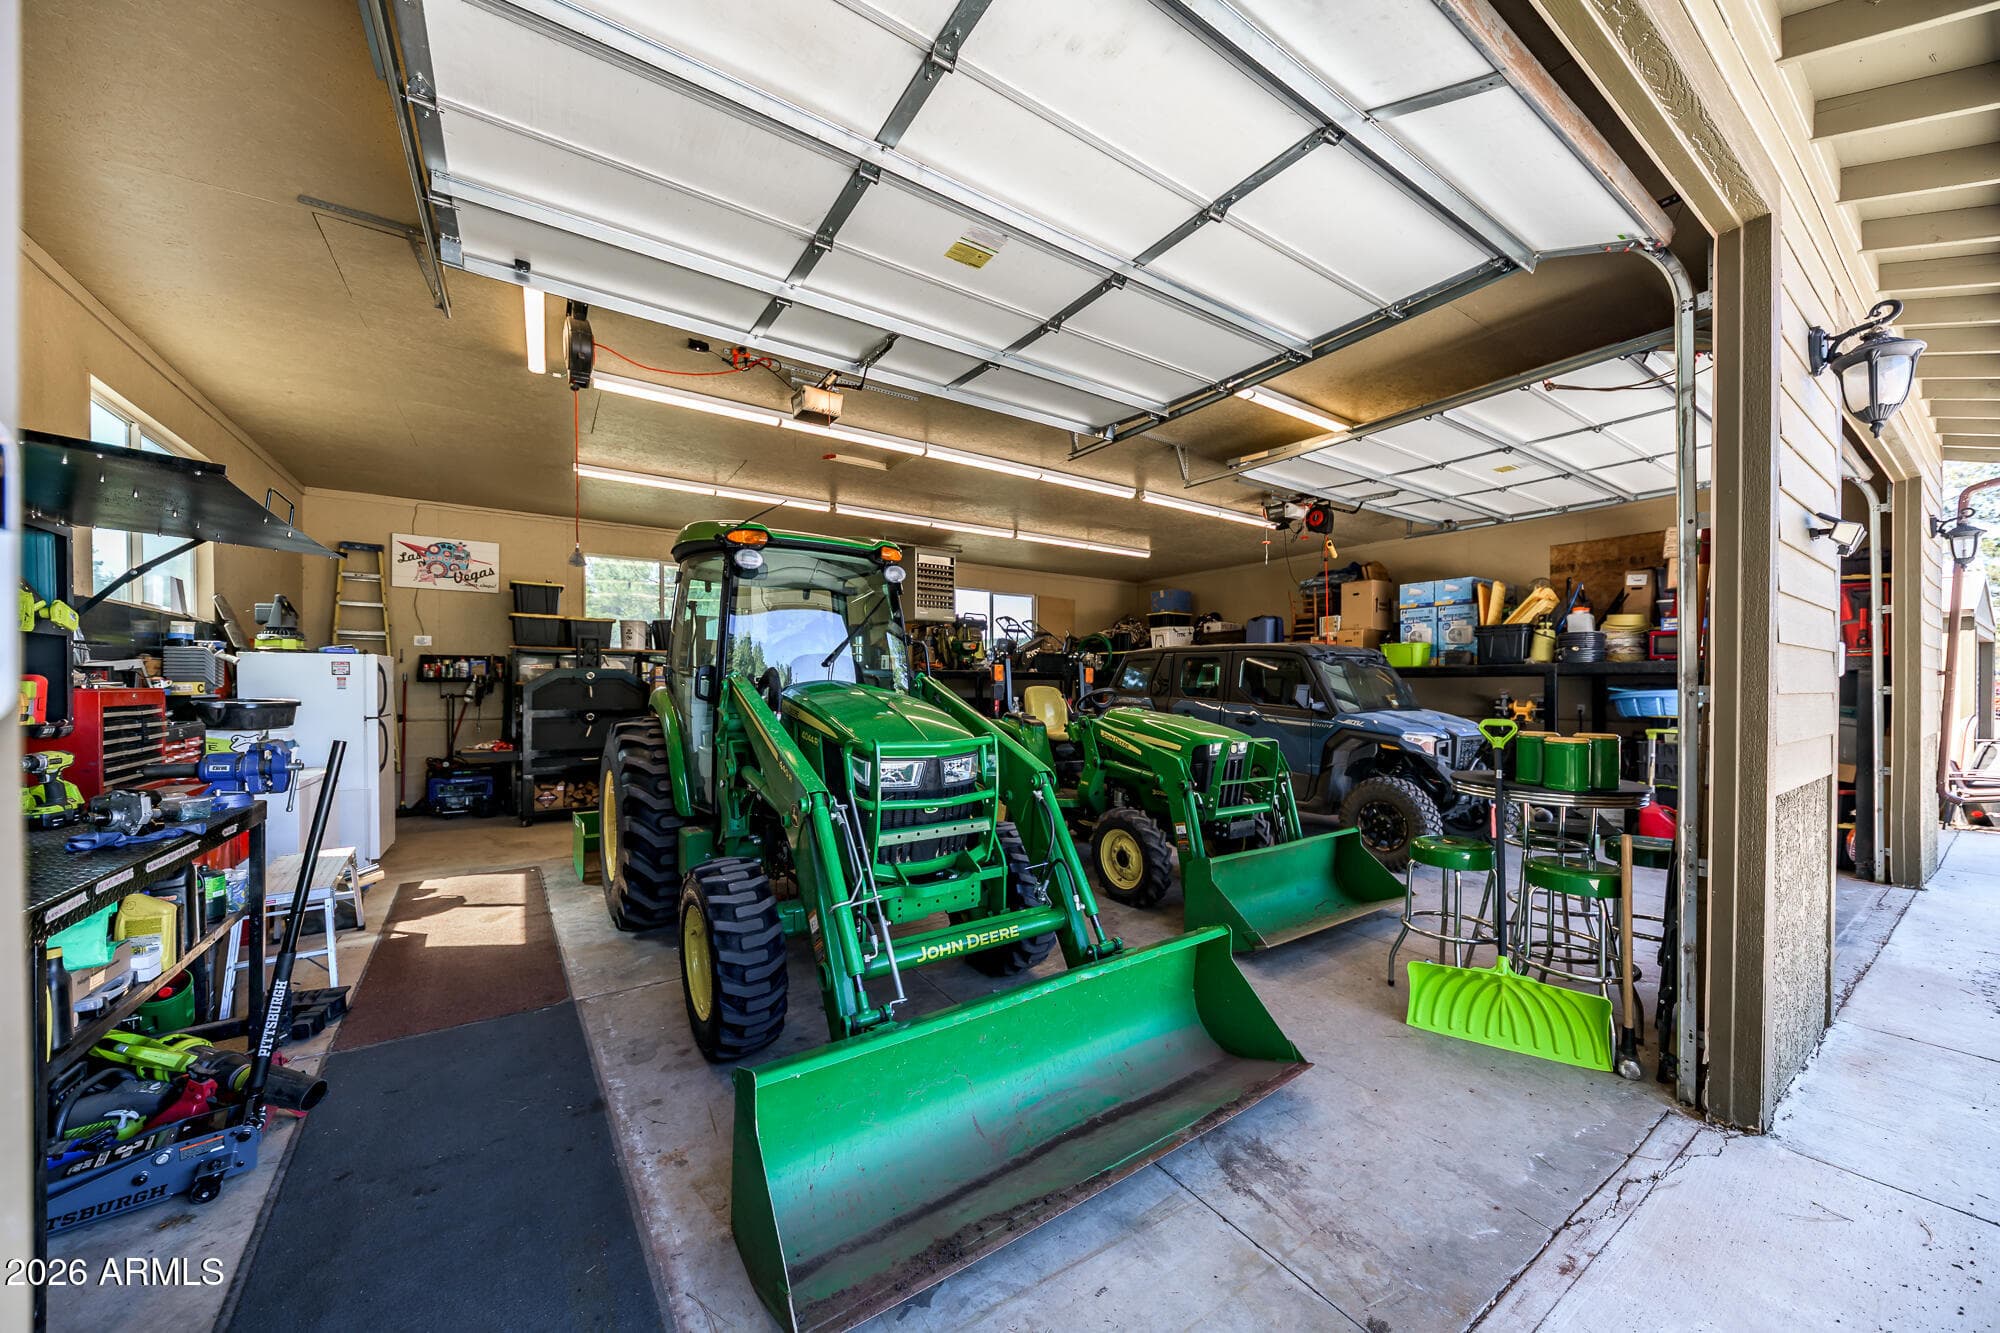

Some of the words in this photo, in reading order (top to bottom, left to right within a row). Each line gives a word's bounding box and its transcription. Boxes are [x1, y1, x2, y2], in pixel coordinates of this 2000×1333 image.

[397, 552, 422, 563] Las
[454, 567, 495, 583] Vegas
[917, 939, 964, 963] JOHN
[966, 925, 1020, 950] DEERE
[257, 978, 288, 1058] PITTSBURGH
